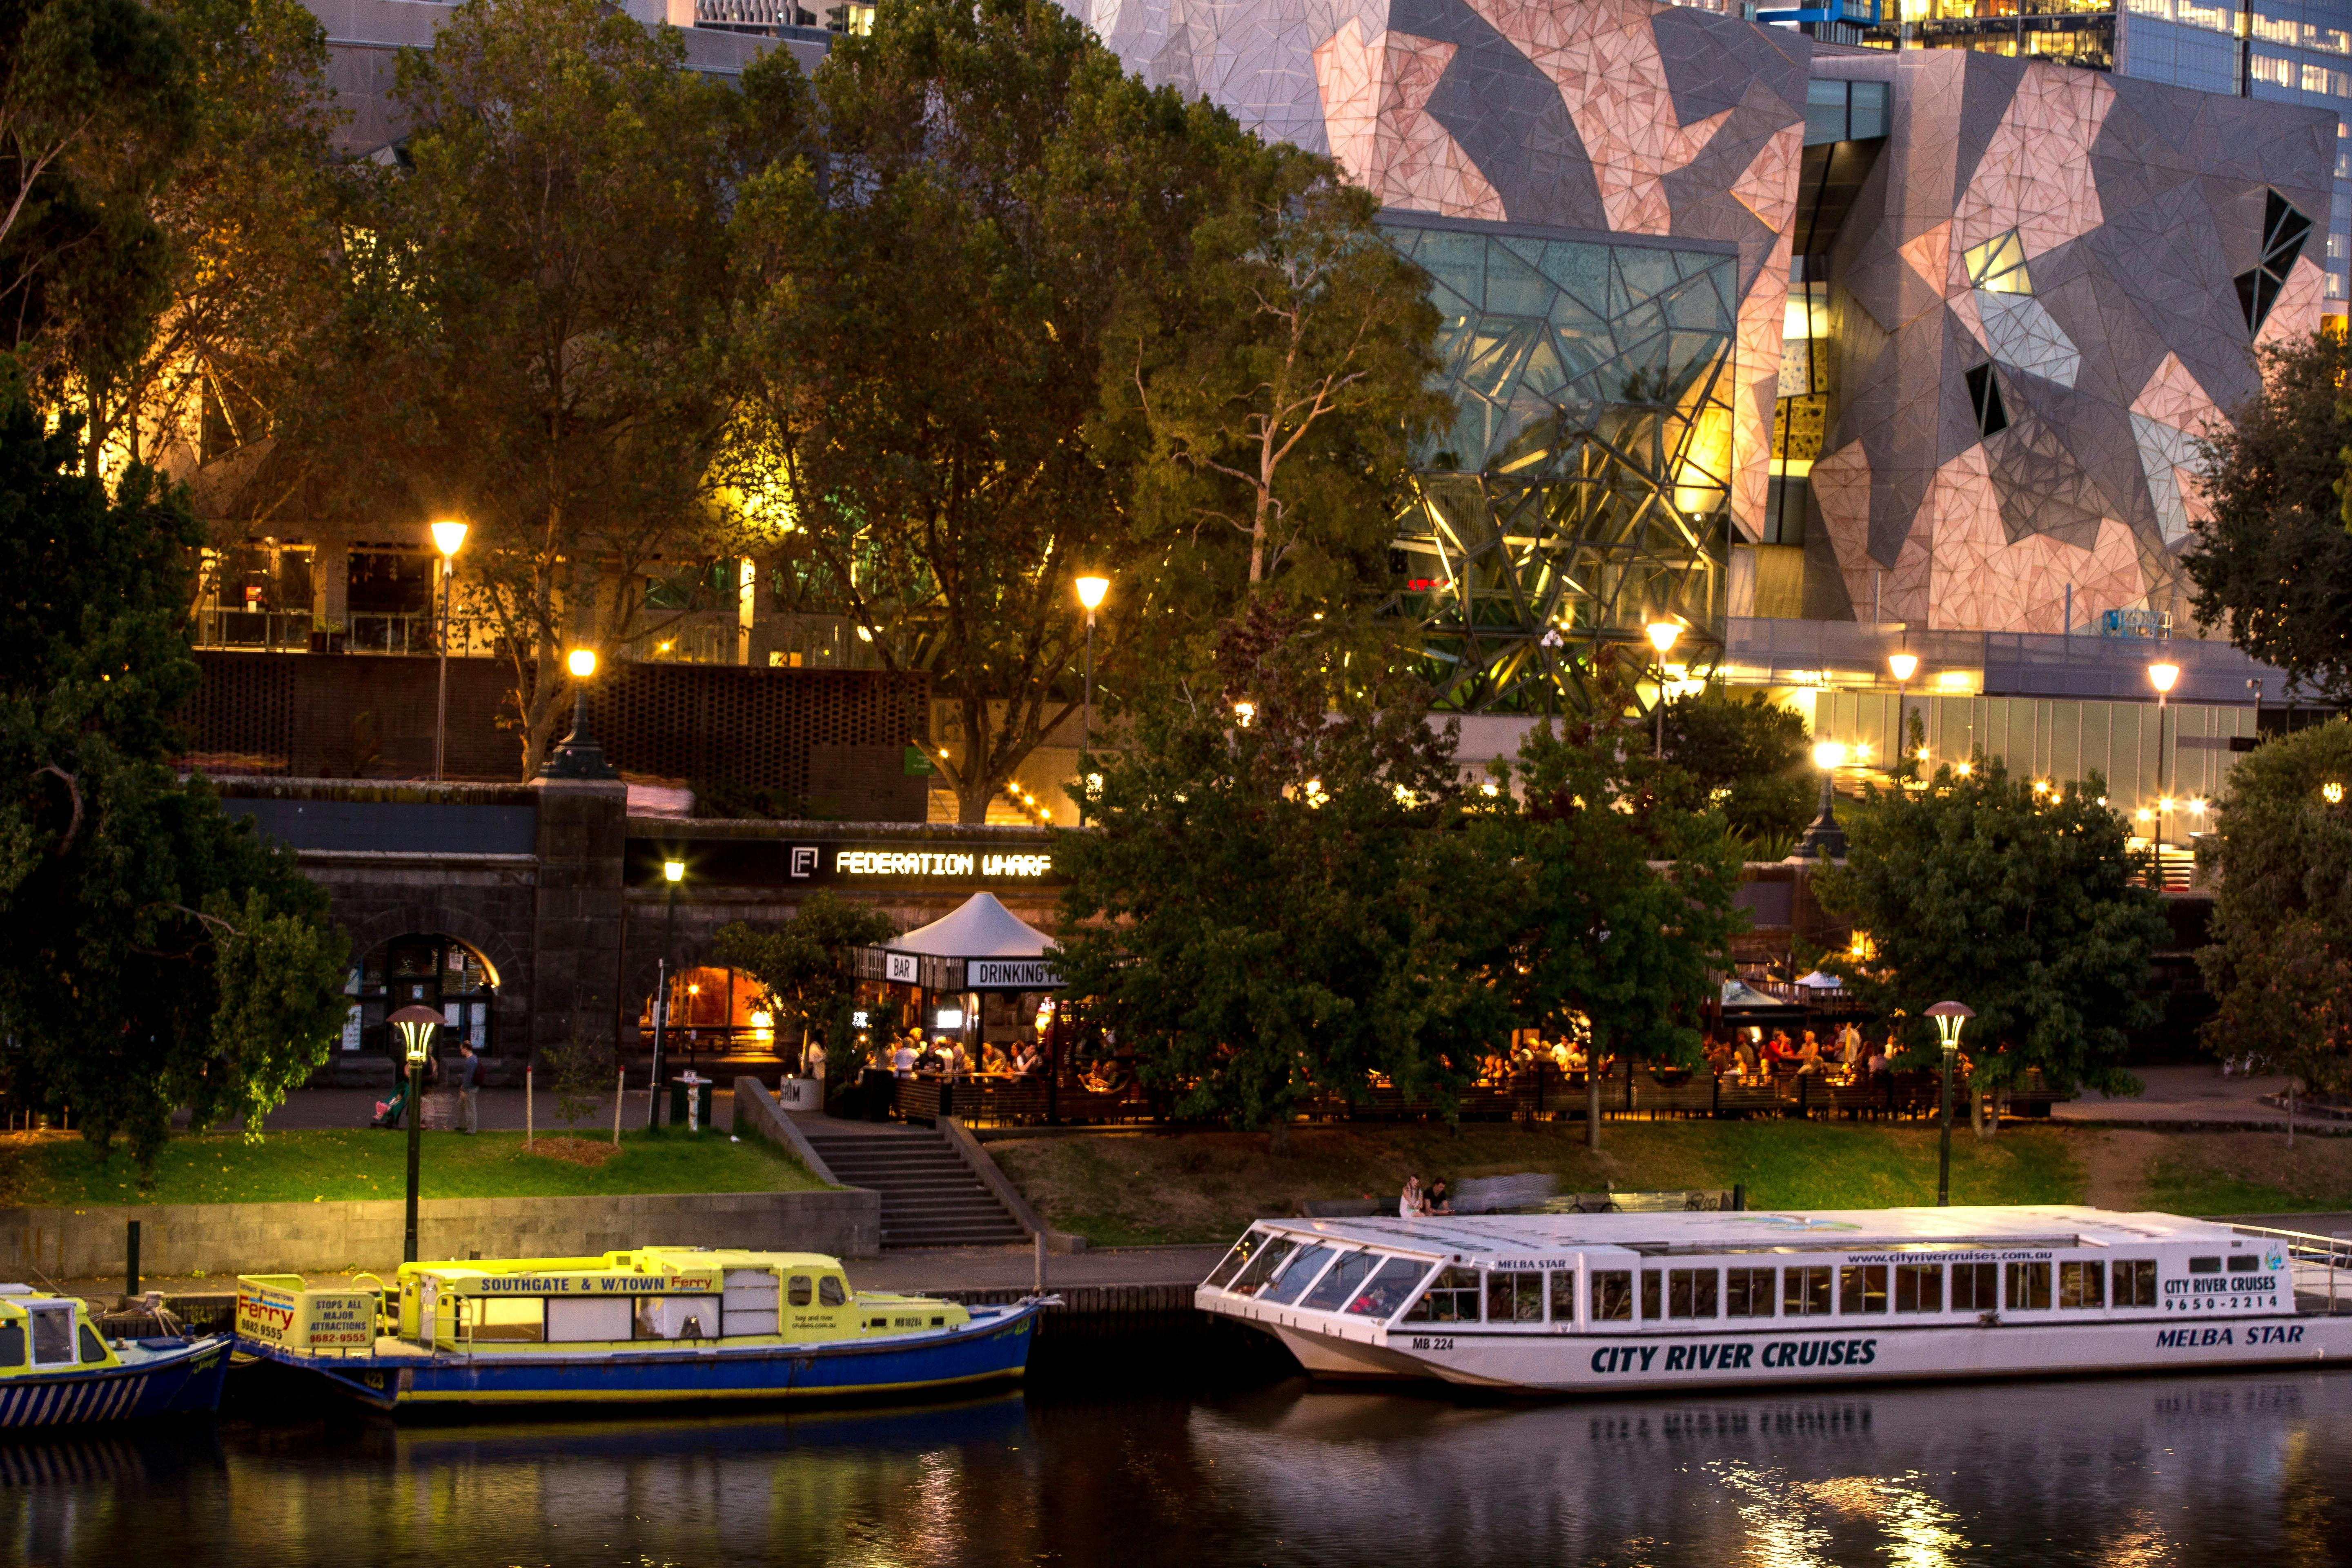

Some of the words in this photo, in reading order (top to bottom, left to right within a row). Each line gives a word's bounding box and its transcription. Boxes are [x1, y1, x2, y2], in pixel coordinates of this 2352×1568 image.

[836, 851, 973, 875] FEDERATION
[982, 854, 1051, 876] WHARF
[893, 957, 910, 978] BAR
[980, 963, 1043, 983] DRINKING
[1498, 1260, 1535, 1268] MELBA
[1538, 1259, 1566, 1268] STAR
[1848, 1250, 2052, 1263] www.cityrivercruises.com.au
[481, 1277, 570, 1292] SOUTHGATE
[581, 1278, 591, 1291] &
[601, 1277, 665, 1292] W/TOWN
[671, 1276, 712, 1290] Ferry
[2165, 1278, 2190, 1294] CITY
[2193, 1277, 2227, 1293] RIVER
[2231, 1275, 2276, 1291] CRUISES
[238, 1294, 294, 1330] Ferry
[316, 1300, 343, 1309] STOPS
[347, 1300, 361, 1309] ALL
[323, 1311, 354, 1320] MAJOR
[260, 1324, 283, 1340] 9555
[310, 1321, 367, 1331] ATTRACTIONS
[310, 1333, 367, 1343] 9682-9555
[1412, 1337, 1430, 1350] MB
[1433, 1338, 1453, 1350] 224
[2156, 1327, 2234, 1348] MELBA
[2245, 1325, 2305, 1345] STAR
[1592, 1345, 1660, 1373] CITY
[1664, 1343, 1754, 1371] RIVER
[1761, 1339, 1878, 1368] CRUISES
